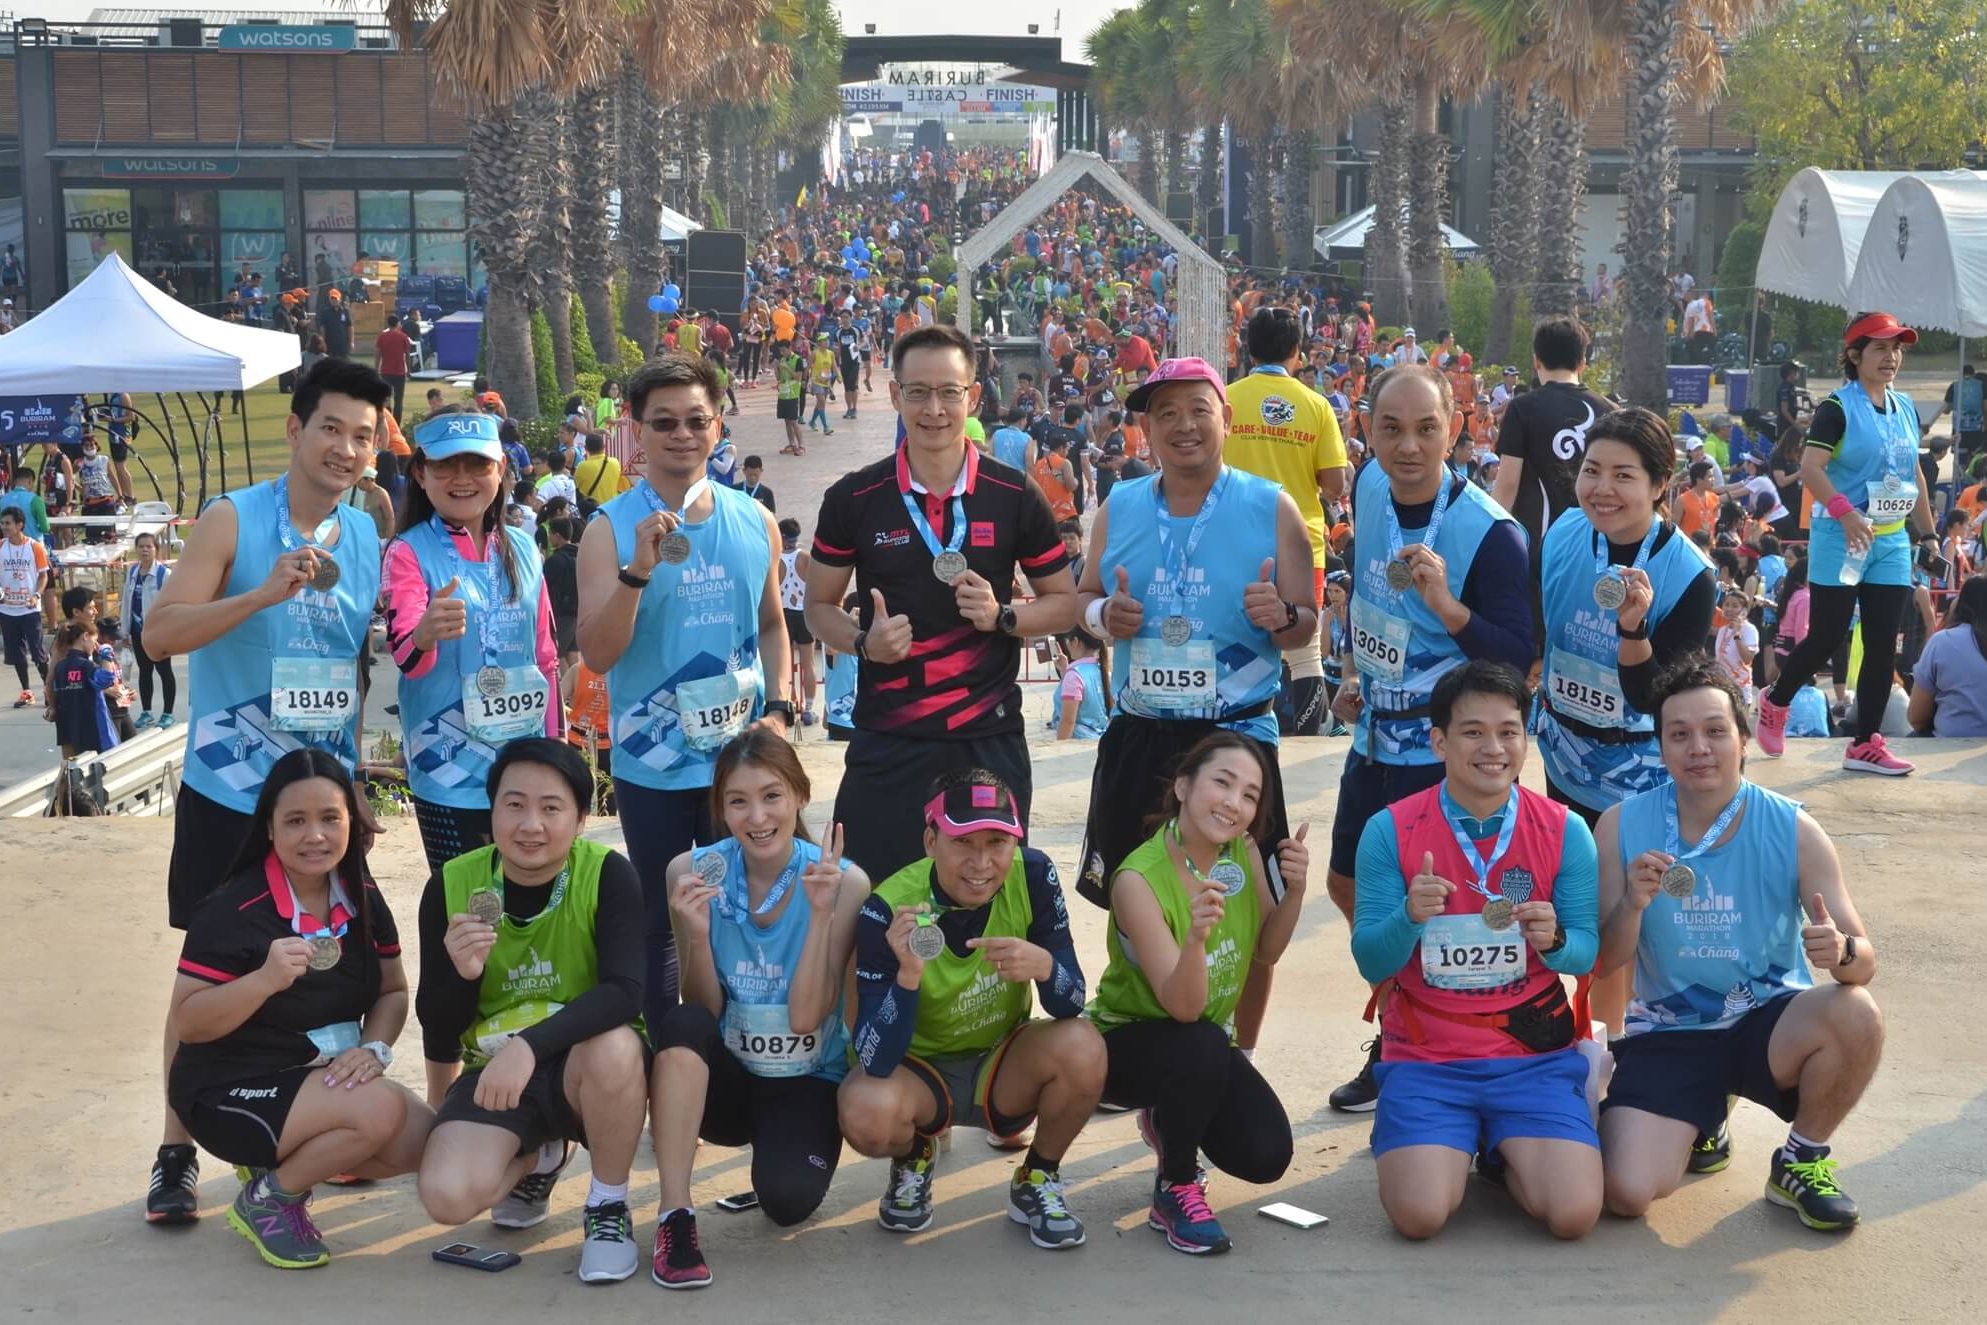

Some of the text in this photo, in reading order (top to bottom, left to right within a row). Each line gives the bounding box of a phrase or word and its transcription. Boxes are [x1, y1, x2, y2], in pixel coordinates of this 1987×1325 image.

[238, 30, 333, 47] watsons
[840, 88, 881, 100] INISH
[986, 88, 1035, 101] FINISH
[123, 160, 217, 172] watsons
[70, 209, 129, 230] more
[448, 420, 480, 435] RUN
[1232, 424, 1317, 443] CARE VALUE TEAM
[1877, 500, 1913, 511] 10626
[677, 578, 735, 598] BURIRAM
[700, 612, 735, 626] Chang
[1353, 626, 1398, 665] 13050
[1564, 622, 1619, 652] BURIRAM
[1141, 669, 1207, 688] 10153
[288, 690, 349, 709] 18149
[482, 690, 545, 718] 13092
[1555, 677, 1616, 713] 18155
[698, 698, 750, 728] 18148
[1673, 911, 1742, 925] BURIRAM
[1440, 945, 1518, 967] 10275
[1698, 946, 1740, 961] Chang
[502, 974, 561, 992] BURIRAM
[727, 974, 787, 991] BURIRAM
[740, 1034, 816, 1054] 10879
